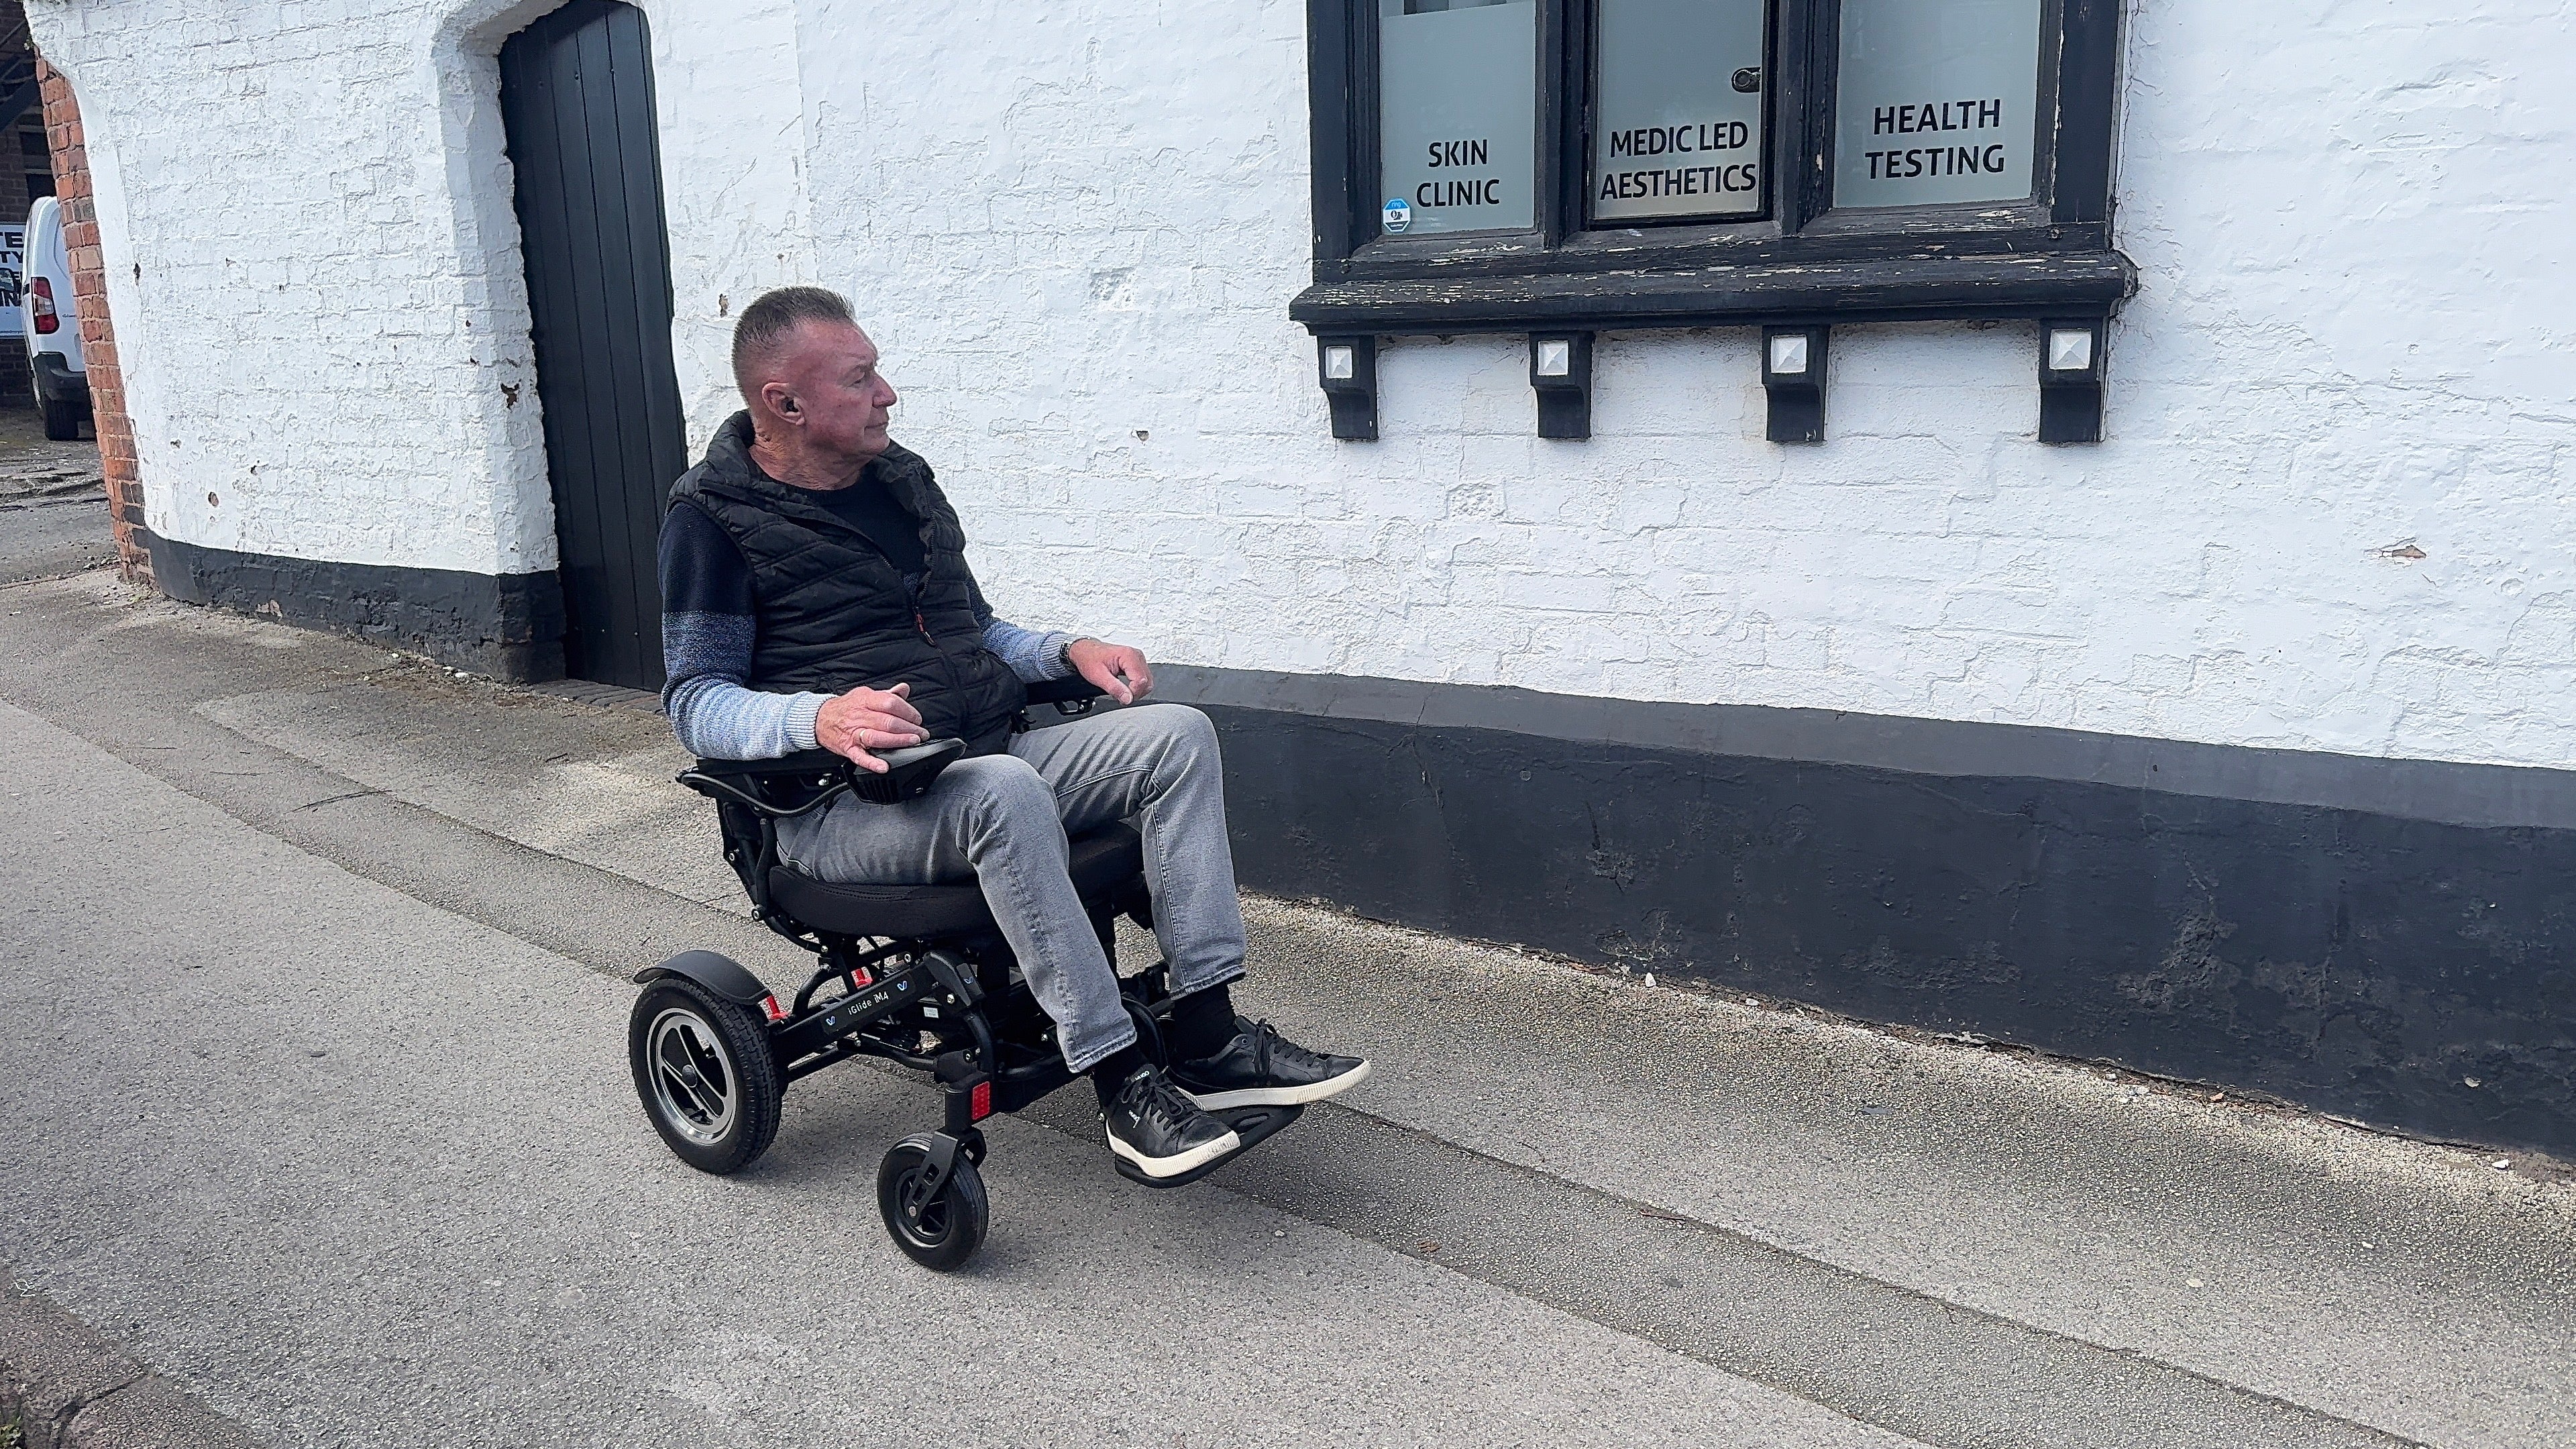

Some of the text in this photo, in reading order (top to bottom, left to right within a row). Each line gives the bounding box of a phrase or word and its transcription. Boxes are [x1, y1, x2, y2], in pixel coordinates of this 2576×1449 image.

[1874, 99, 2000, 135] HEALTH
[1428, 139, 1487, 168] SKIN
[1610, 121, 1748, 158] MEDIC LED
[1864, 144, 2004, 179] TESTING
[1416, 179, 1500, 207] CLINIC
[1600, 164, 1756, 201] AESTHETICS
[0, 231, 24, 248] E
